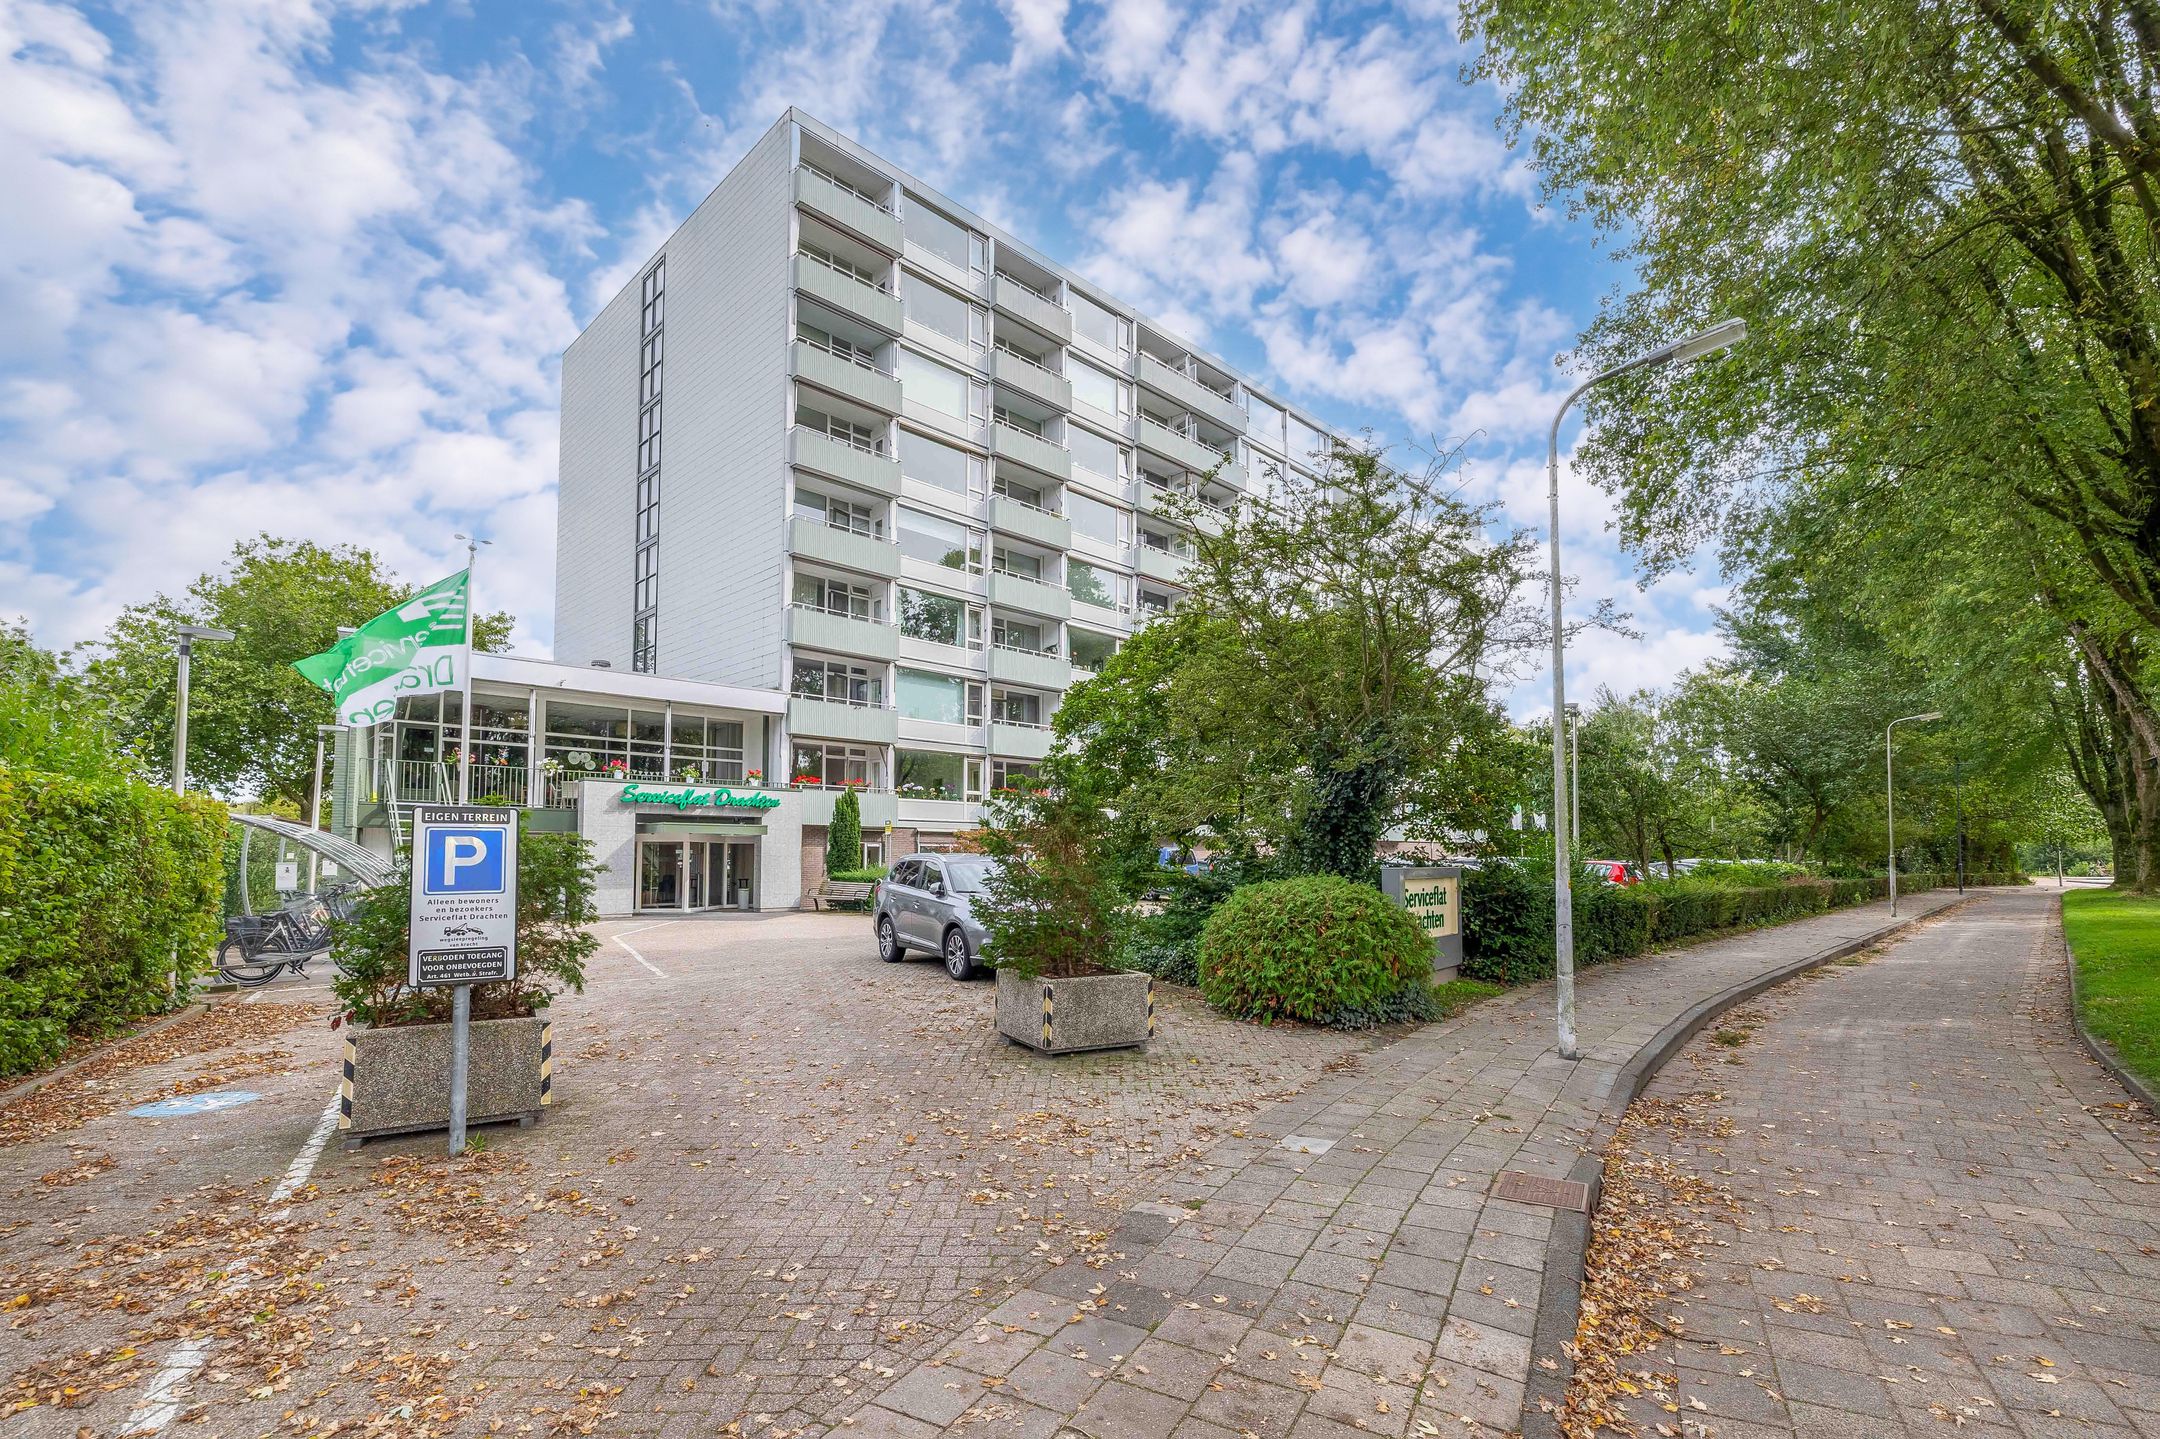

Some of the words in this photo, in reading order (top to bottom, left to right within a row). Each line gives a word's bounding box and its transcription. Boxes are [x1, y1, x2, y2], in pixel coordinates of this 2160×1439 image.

[620, 784, 710, 810] Serviceflat
[713, 788, 781, 809] Drachten
[424, 812, 459, 821] EIGEN
[462, 813, 508, 822] TERREIN
[444, 835, 487, 886] P
[458, 897, 499, 905] bewoners
[1404, 885, 1447, 908] Serviceflat
[449, 905, 493, 913] bezoekers
[419, 914, 467, 922] Serviceflat
[469, 912, 508, 920] Drachten
[1420, 909, 1445, 930] chten
[422, 954, 465, 962] VERBODEN
[466, 952, 503, 960] TOEGANG
[422, 964, 444, 972] VOOR
[446, 961, 503, 970] ONBEVOEGDEN
